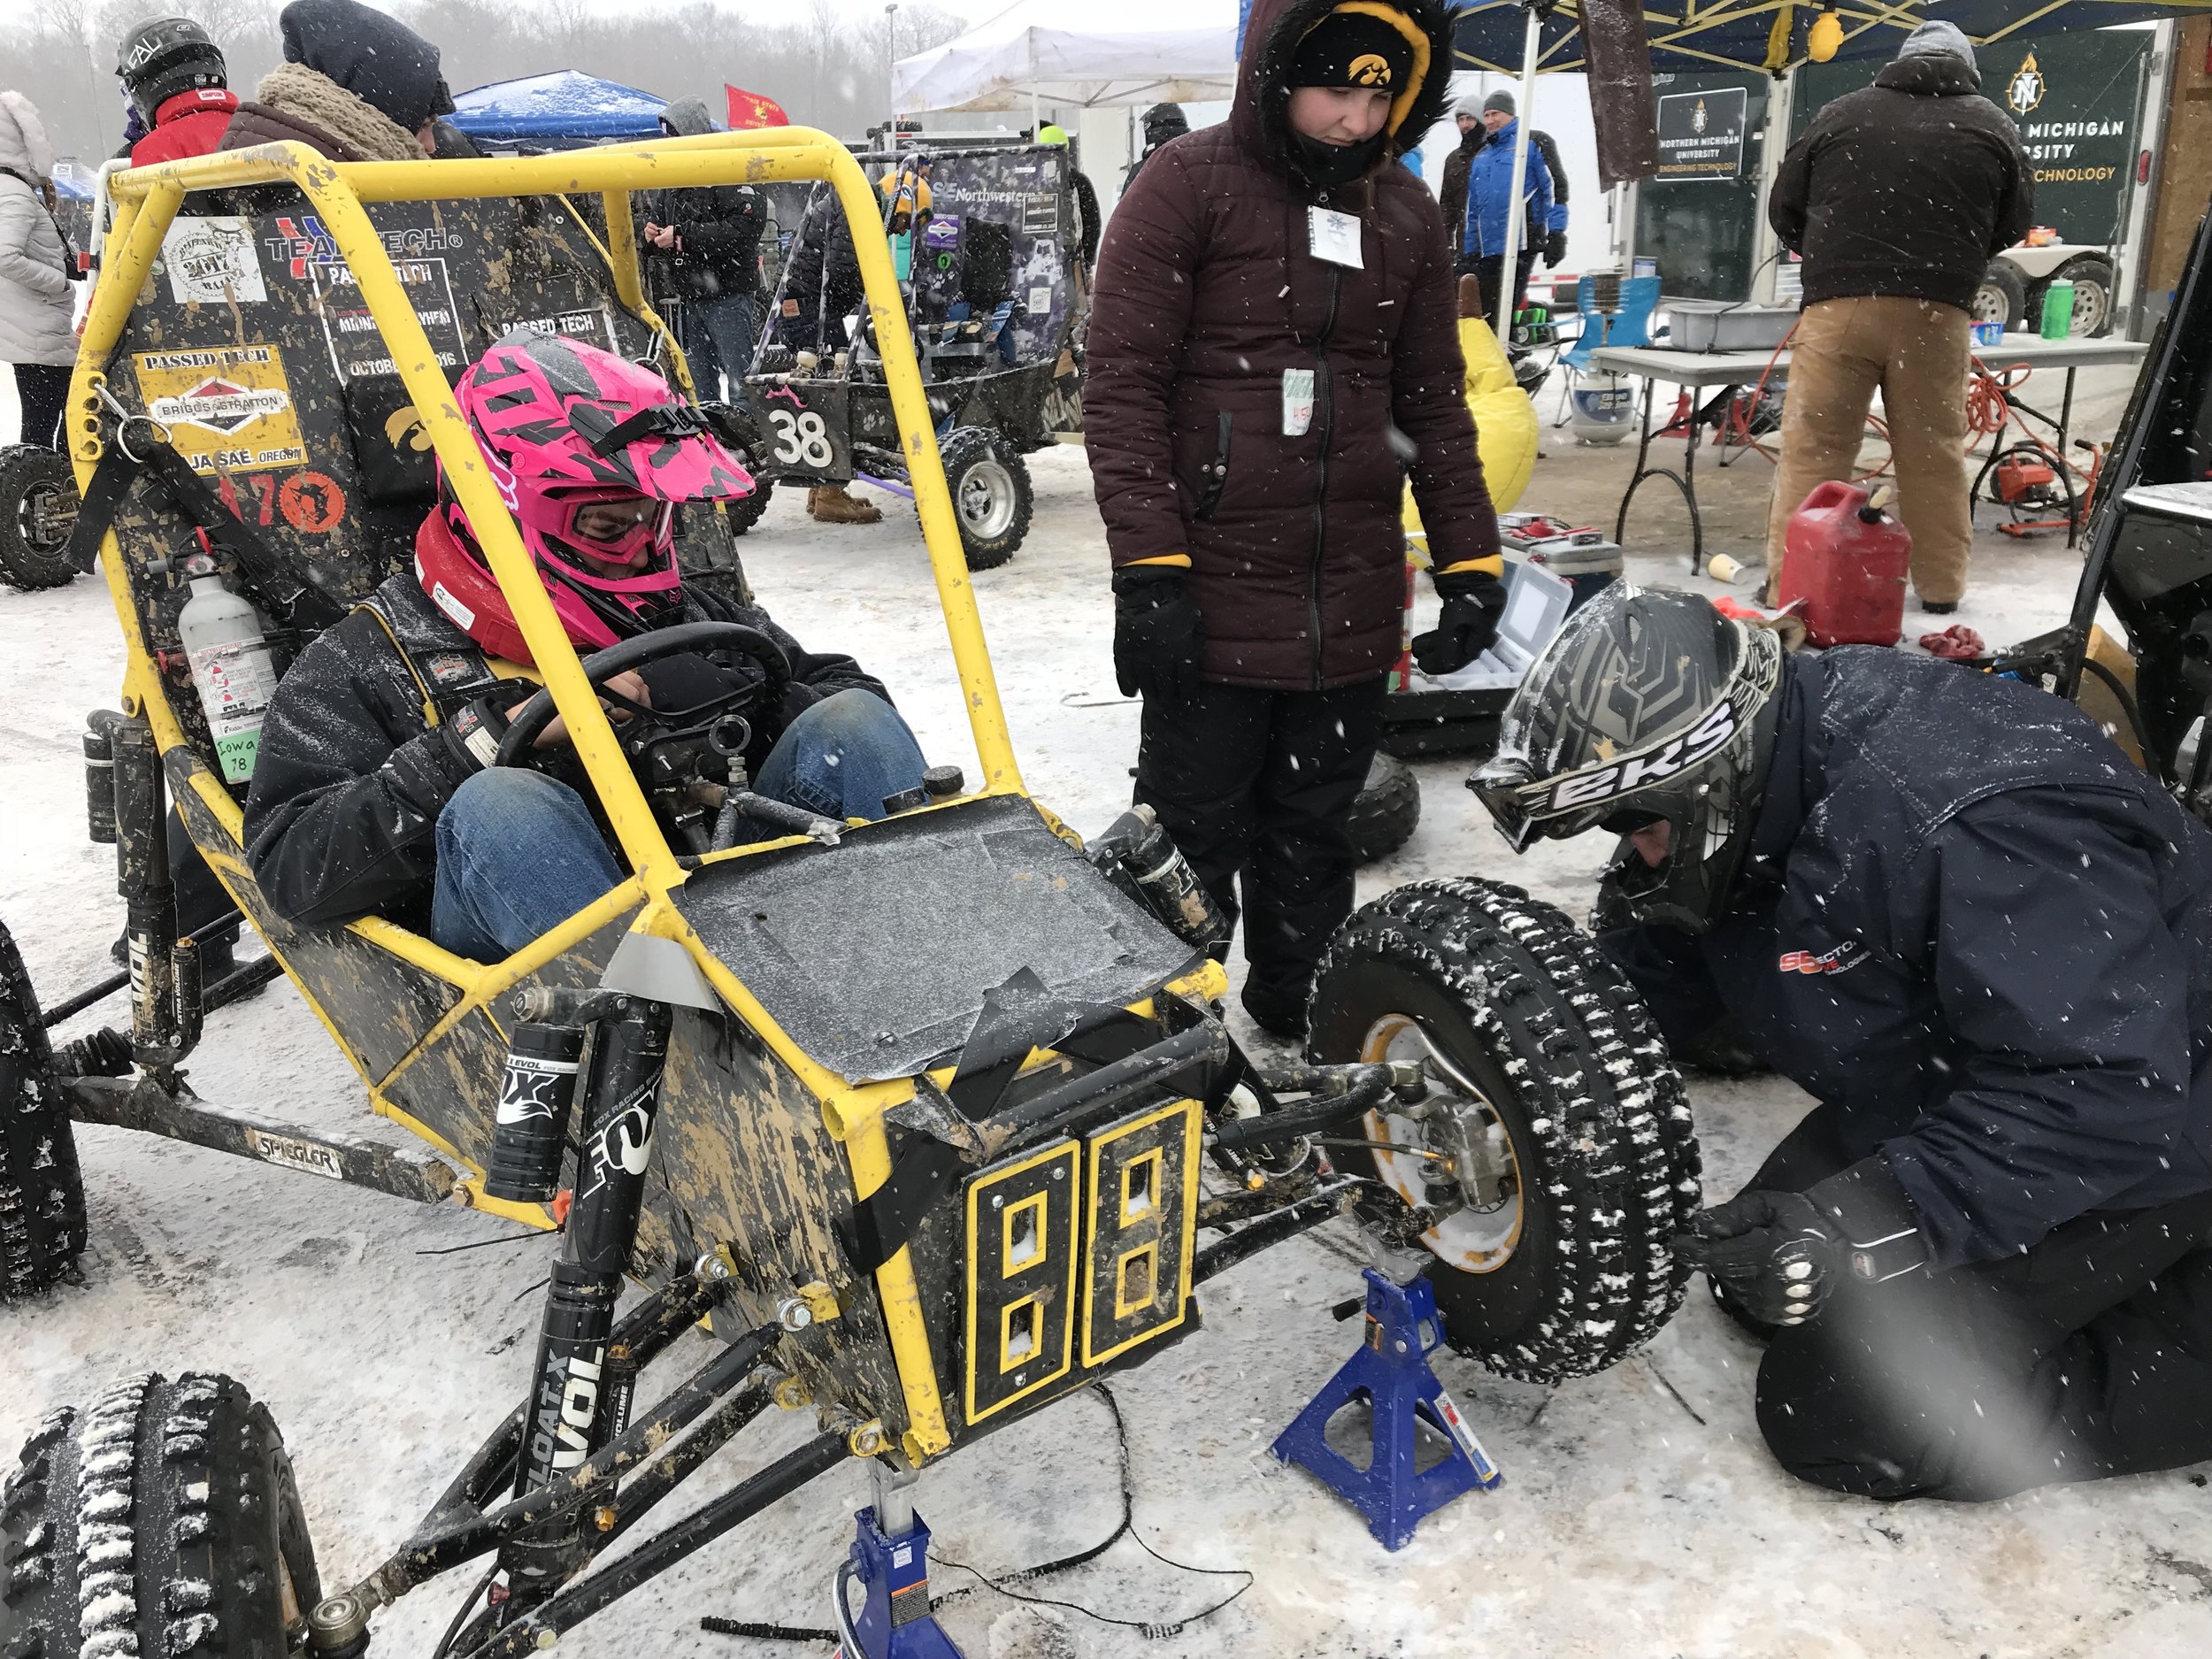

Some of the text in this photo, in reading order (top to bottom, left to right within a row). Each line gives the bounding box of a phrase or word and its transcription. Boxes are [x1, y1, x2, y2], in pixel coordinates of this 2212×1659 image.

[2029, 120, 2124, 138] MICHIGAN
[1660, 135, 1740, 149] NORTHERN MICHIGAN
[1676, 149, 1720, 159] UNIVERSITY
[2024, 143, 2076, 160] RSITY
[2034, 166, 2116, 182] CHNOLOGY
[559, 314, 595, 334] TECH
[144, 349, 270, 371] PASSED TECH
[768, 409, 833, 468] 38
[258, 448, 303, 464] OREGON
[217, 739, 257, 757] Iowa
[514, 1059, 541, 1071] EVOL
[593, 1111, 611, 1130] FOX
[611, 1082, 646, 1115] RACING
[260, 1137, 335, 1173] SPIEGLER
[549, 1346, 605, 1484] VOL
